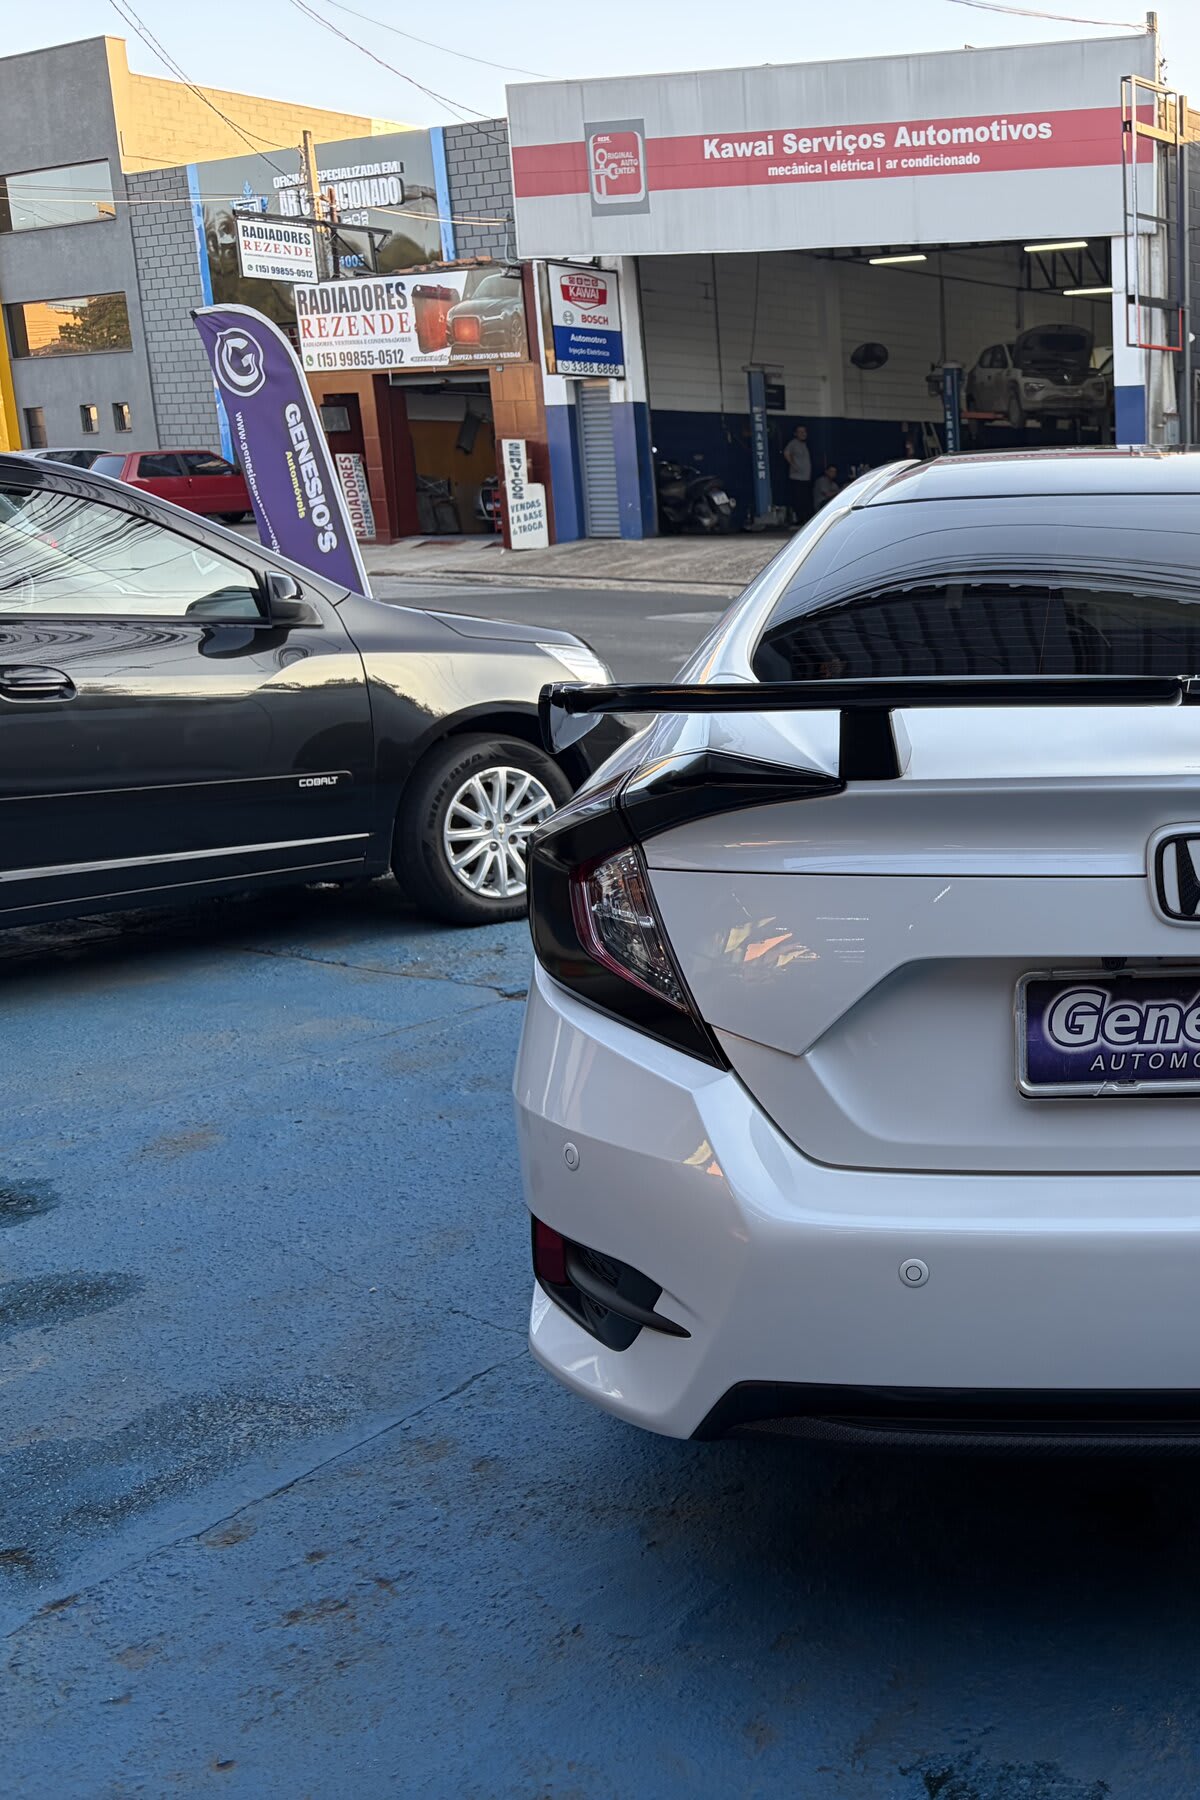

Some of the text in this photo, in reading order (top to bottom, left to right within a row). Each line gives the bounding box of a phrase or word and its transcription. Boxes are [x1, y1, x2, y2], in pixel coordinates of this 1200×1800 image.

[704, 119, 1053, 159] Kawai Serviços Automotivos
[768, 163, 822, 176] mecânica
[829, 159, 875, 172] elétrica
[885, 158, 898, 170] ar
[901, 152, 981, 168] condicionado
[241, 225, 311, 246] RADIADORES
[243, 239, 313, 258] REZENDE
[255, 264, 313, 279] (15) 99855-0512
[296, 282, 408, 316] RADIADORES
[569, 286, 600, 299] KAWAI
[300, 312, 411, 339] REZENDE
[581, 314, 609, 325] BOSCH
[317, 352, 337, 367] (15)
[339, 349, 405, 367] 99855-0512
[571, 361, 620, 375] 3388.6866
[285, 451, 305, 519] Automóveis
[339, 456, 367, 537] RADIADORES
[510, 499, 541, 513] VENDAS
[523, 509, 543, 522] BASE
[518, 521, 543, 534] TROCA
[299, 776, 339, 788] COBALT
